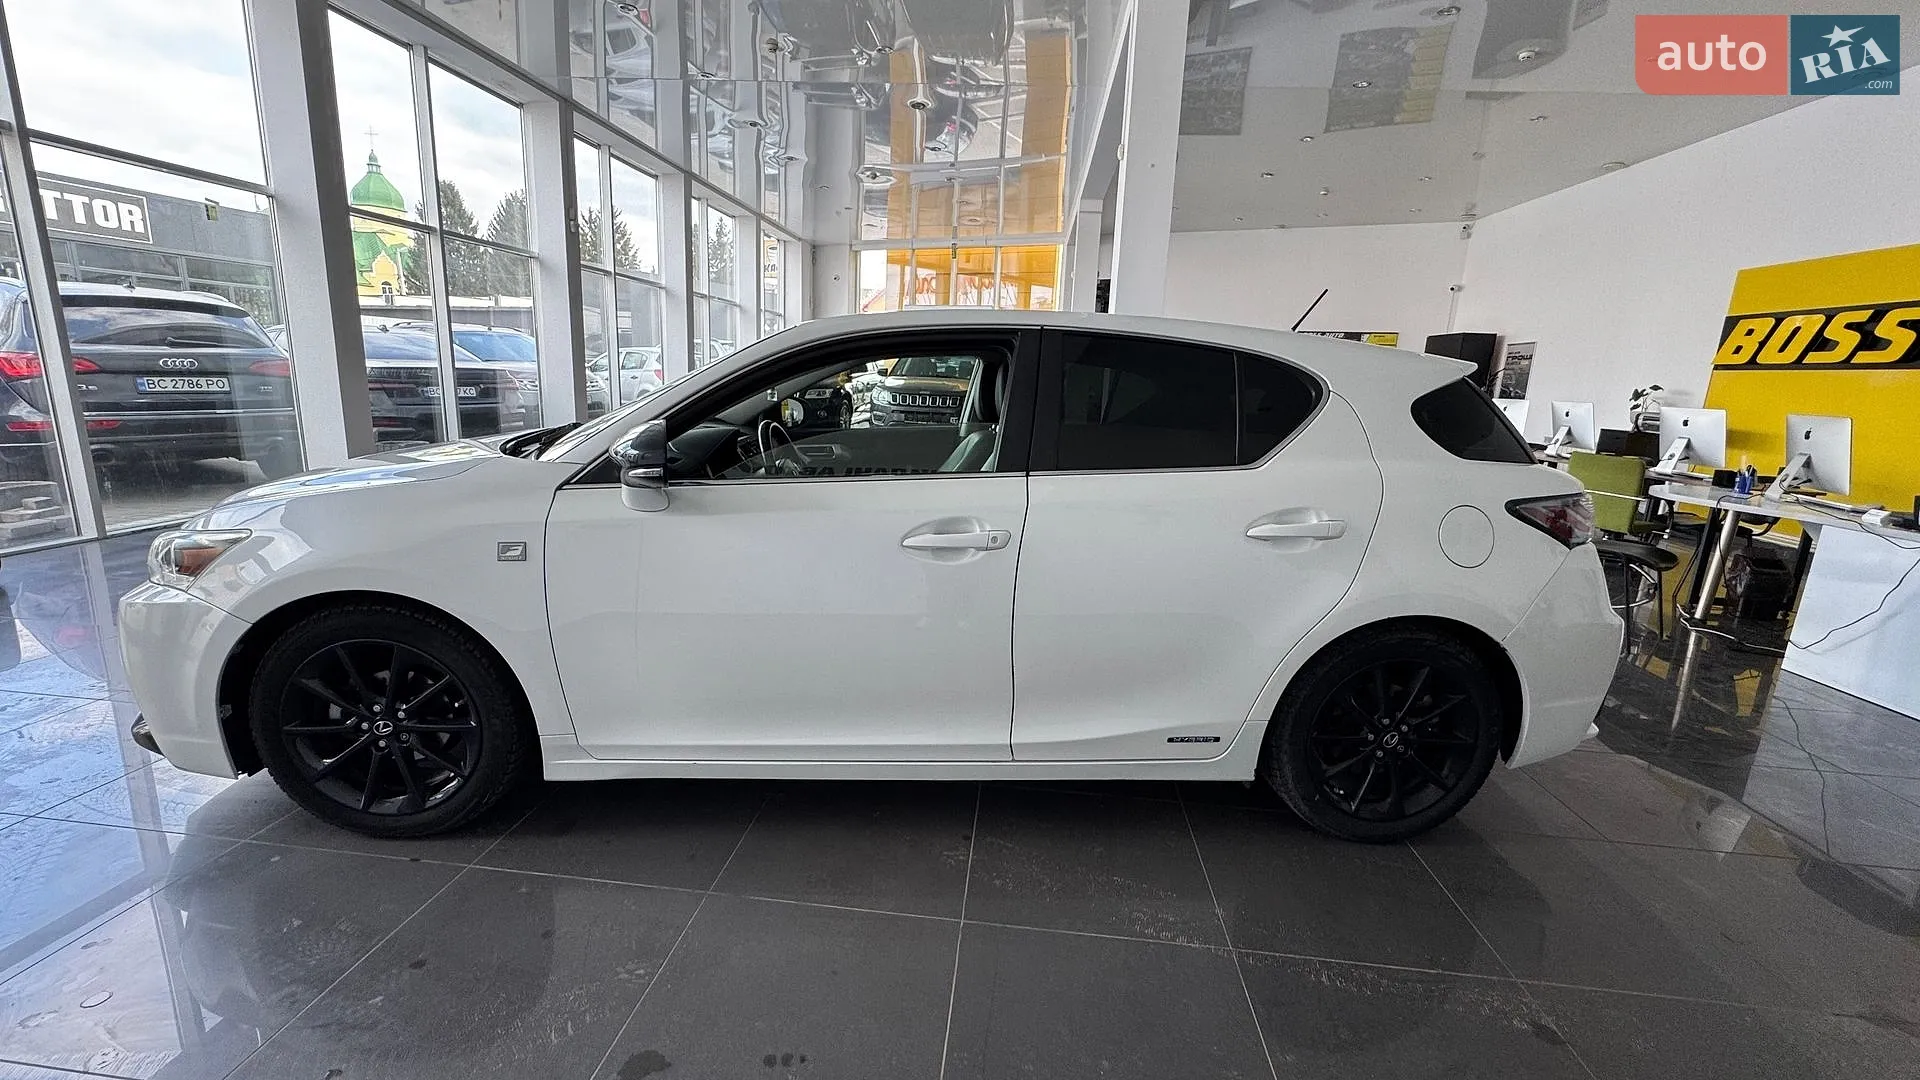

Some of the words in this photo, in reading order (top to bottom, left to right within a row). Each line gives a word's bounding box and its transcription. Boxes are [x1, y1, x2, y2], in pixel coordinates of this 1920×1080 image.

[1711, 307, 1920, 365] BOSS
[146, 378, 168, 389] BC
[170, 378, 203, 389] 2786
